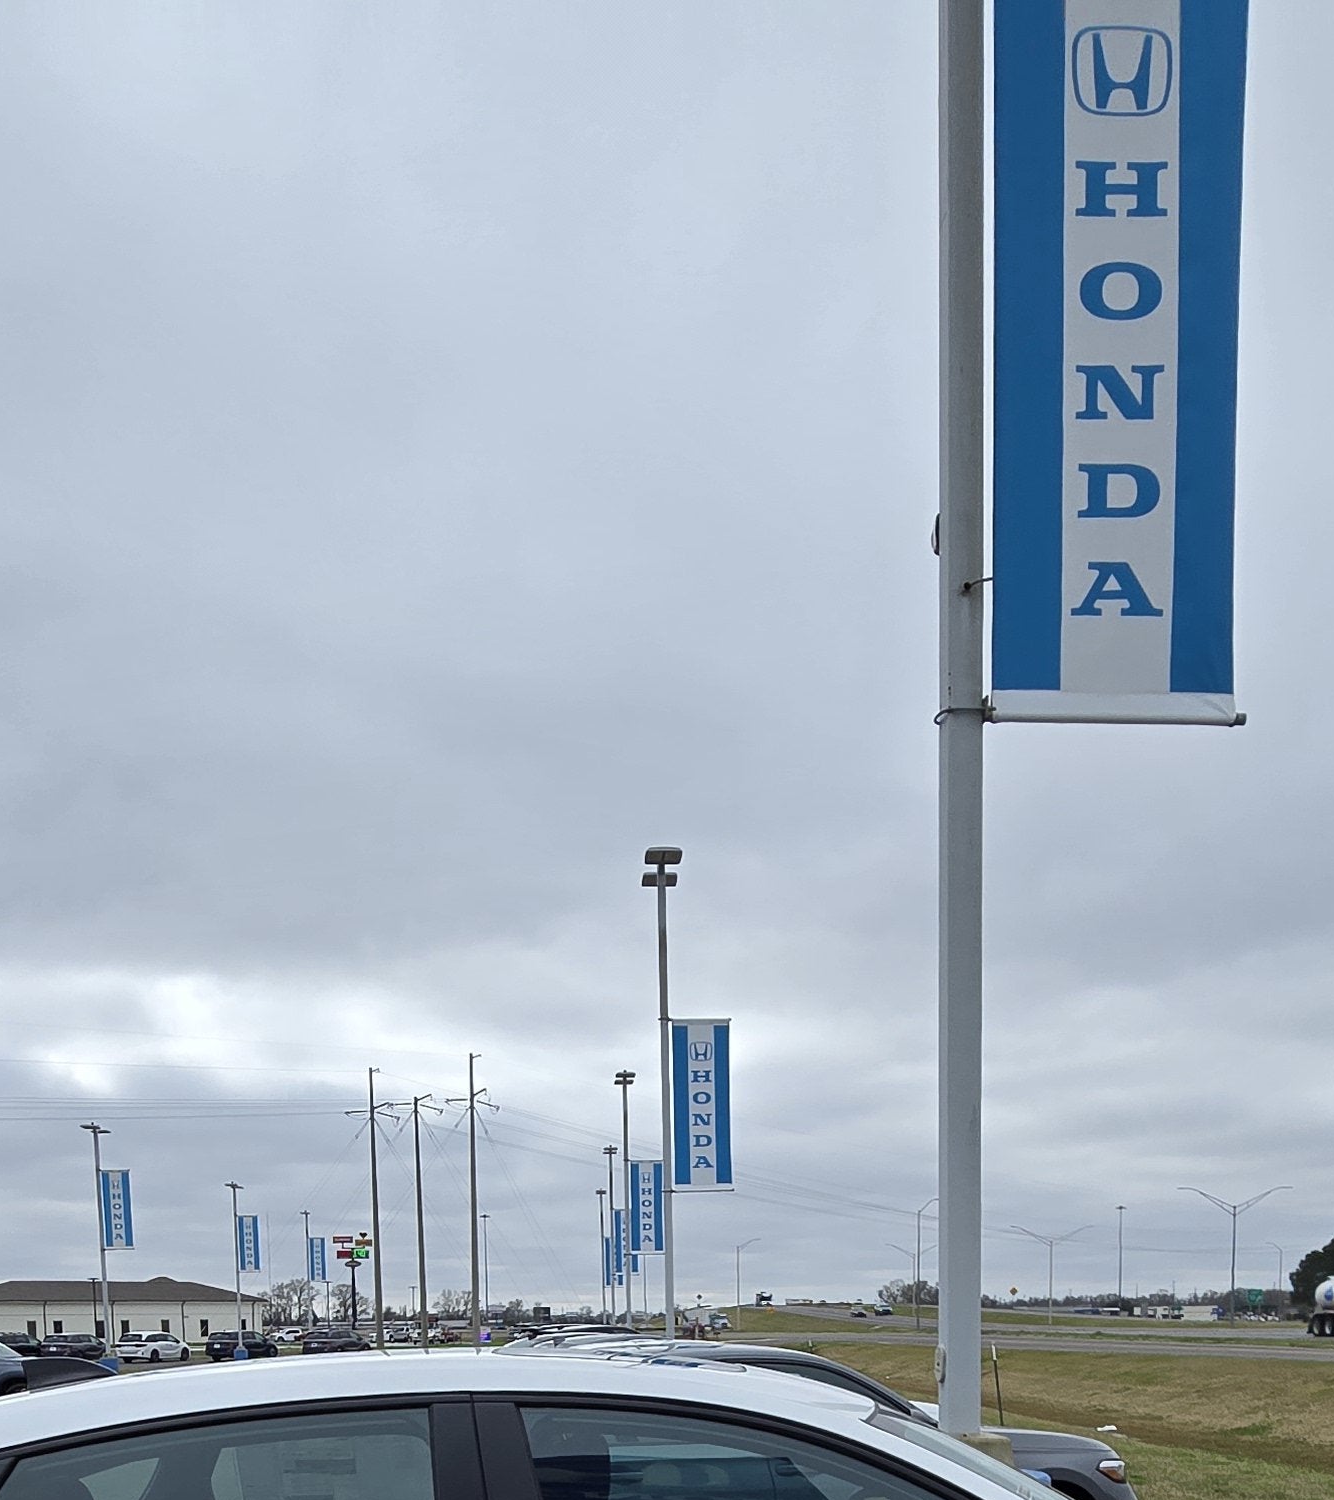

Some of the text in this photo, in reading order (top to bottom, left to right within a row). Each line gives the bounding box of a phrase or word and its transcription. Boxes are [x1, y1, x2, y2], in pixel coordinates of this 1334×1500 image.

[1070, 160, 1168, 617] HONDA
[691, 1070, 714, 1169] HONDA
[112, 1193, 124, 1240] HONDA
[641, 1188, 653, 1242] HONDA
